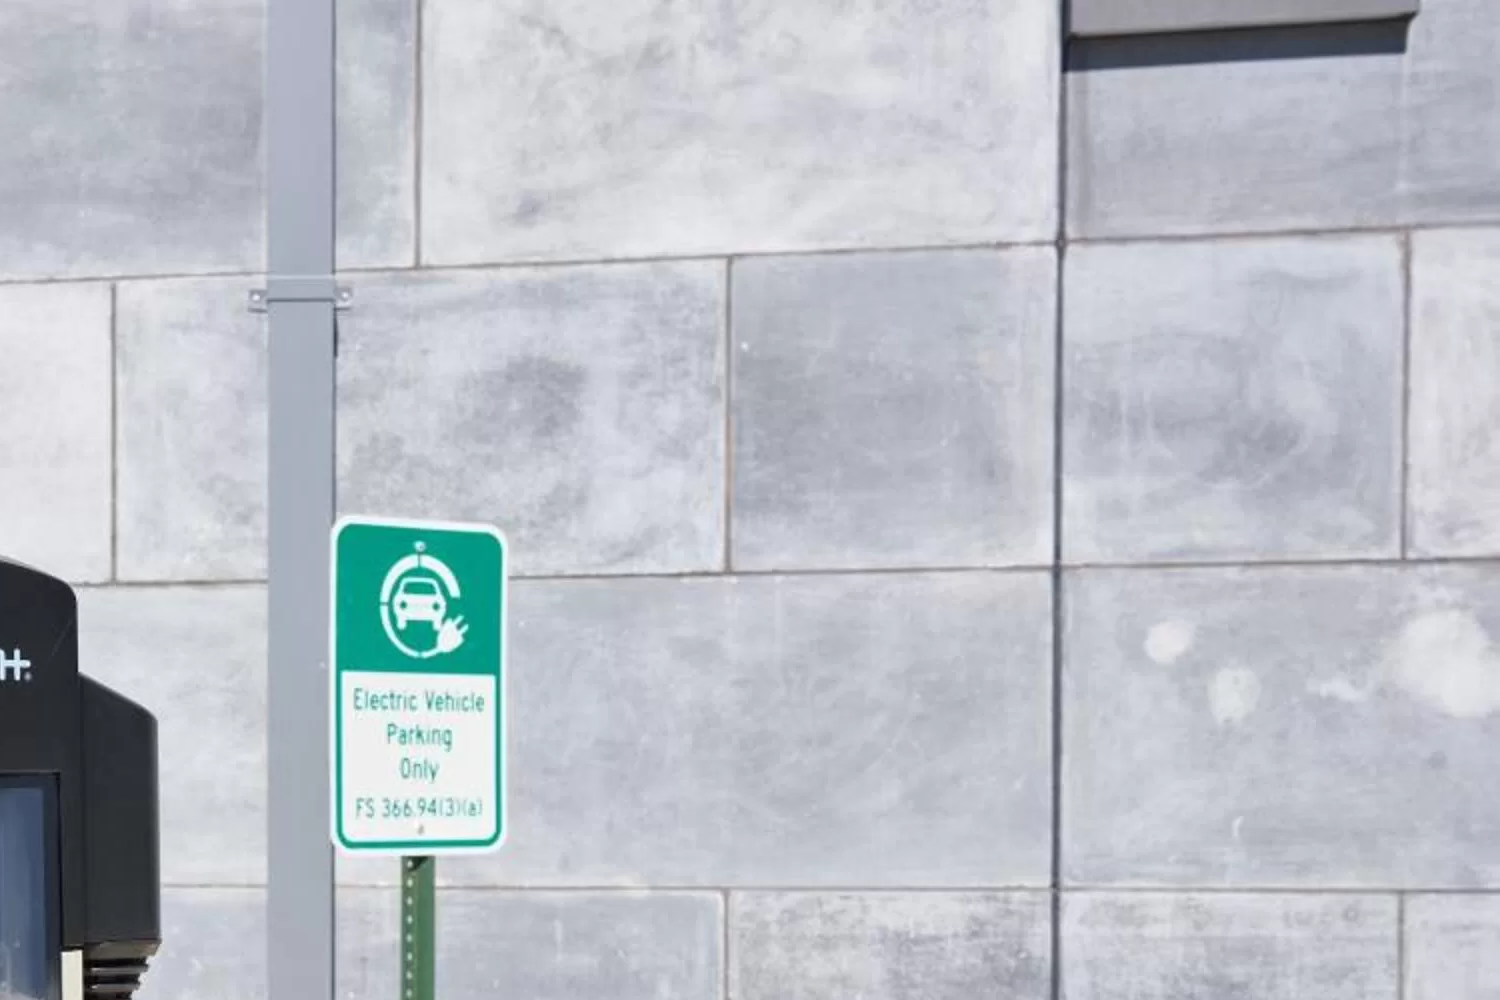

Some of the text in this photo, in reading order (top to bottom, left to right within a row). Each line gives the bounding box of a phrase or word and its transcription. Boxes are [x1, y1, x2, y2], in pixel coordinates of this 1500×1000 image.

[353, 687, 485, 712] Electric Vehicle
[387, 723, 453, 752] Parking
[400, 757, 440, 782] Only
[355, 797, 375, 818] FS
